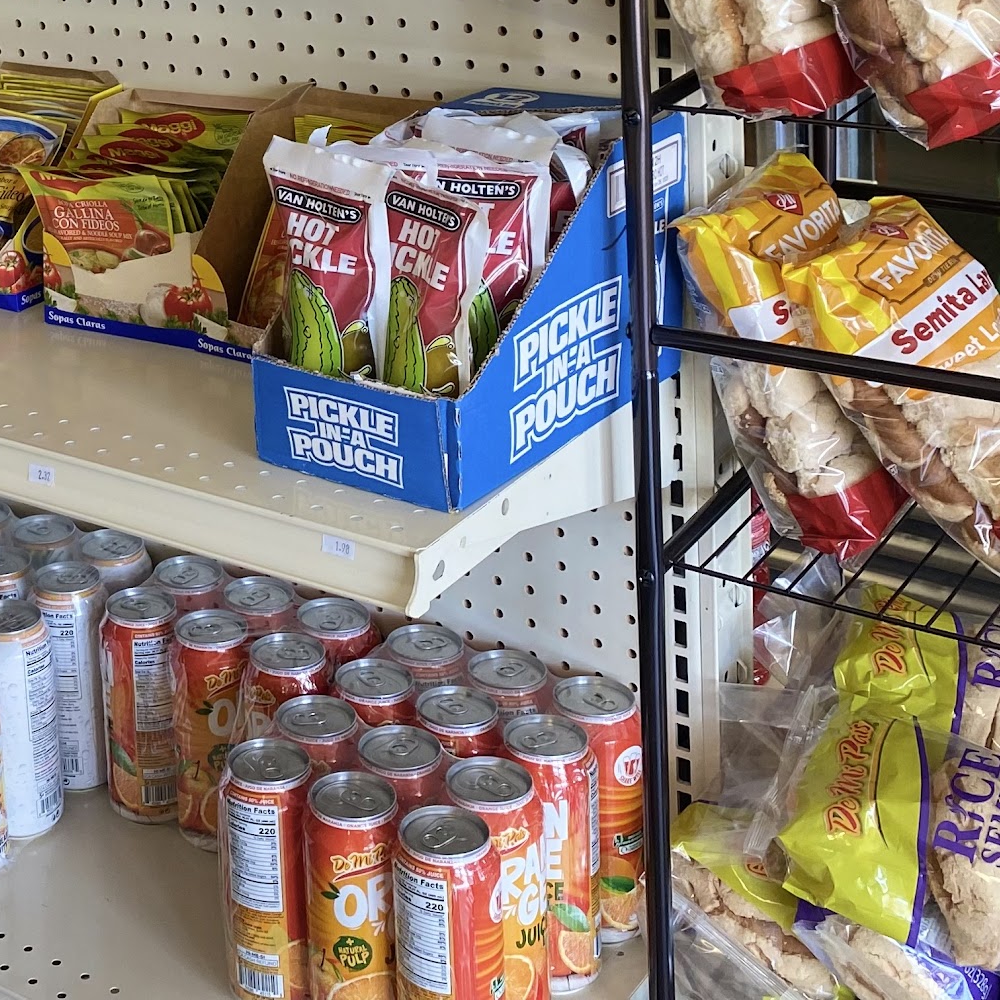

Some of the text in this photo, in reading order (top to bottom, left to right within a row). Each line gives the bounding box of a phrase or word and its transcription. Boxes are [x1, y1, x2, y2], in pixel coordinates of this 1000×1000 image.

[74, 200, 108, 209] CRIOLLA
[450, 181, 516, 196] HOLTEN'S
[54, 205, 115, 221] GALLINA
[278, 189, 358, 221] VAN HOLTEN'S
[391, 194, 456, 228] VAN HOLTEN'S
[52, 217, 120, 232] CON FIDEOS
[287, 211, 340, 246] HOT
[398, 218, 440, 250] HOT
[292, 240, 358, 275] CKLE
[870, 226, 950, 292] FAVORITA
[21, 288, 42, 306] Sopas
[48, 310, 106, 330] Sopas Claras
[519, 288, 618, 382] PICKLE
[891, 282, 976, 356] Semita
[197, 338, 224, 354] Sopas
[938, 336, 986, 369] weet
[545, 344, 592, 386] IN-A
[290, 391, 398, 440] PICKLE
[515, 354, 619, 452] POUCH
[319, 423, 367, 448] IN-A
[291, 434, 401, 481] POUCH
[827, 765, 866, 800] Mi
[254, 806, 276, 815] Facts
[824, 798, 862, 836] De
[932, 747, 1000, 865] RICE
[258, 827, 276, 835] 220
[420, 879, 444, 890] Facts
[425, 901, 444, 911] 220
[337, 944, 368, 955] NATURAL
[339, 951, 370, 968] PULP
